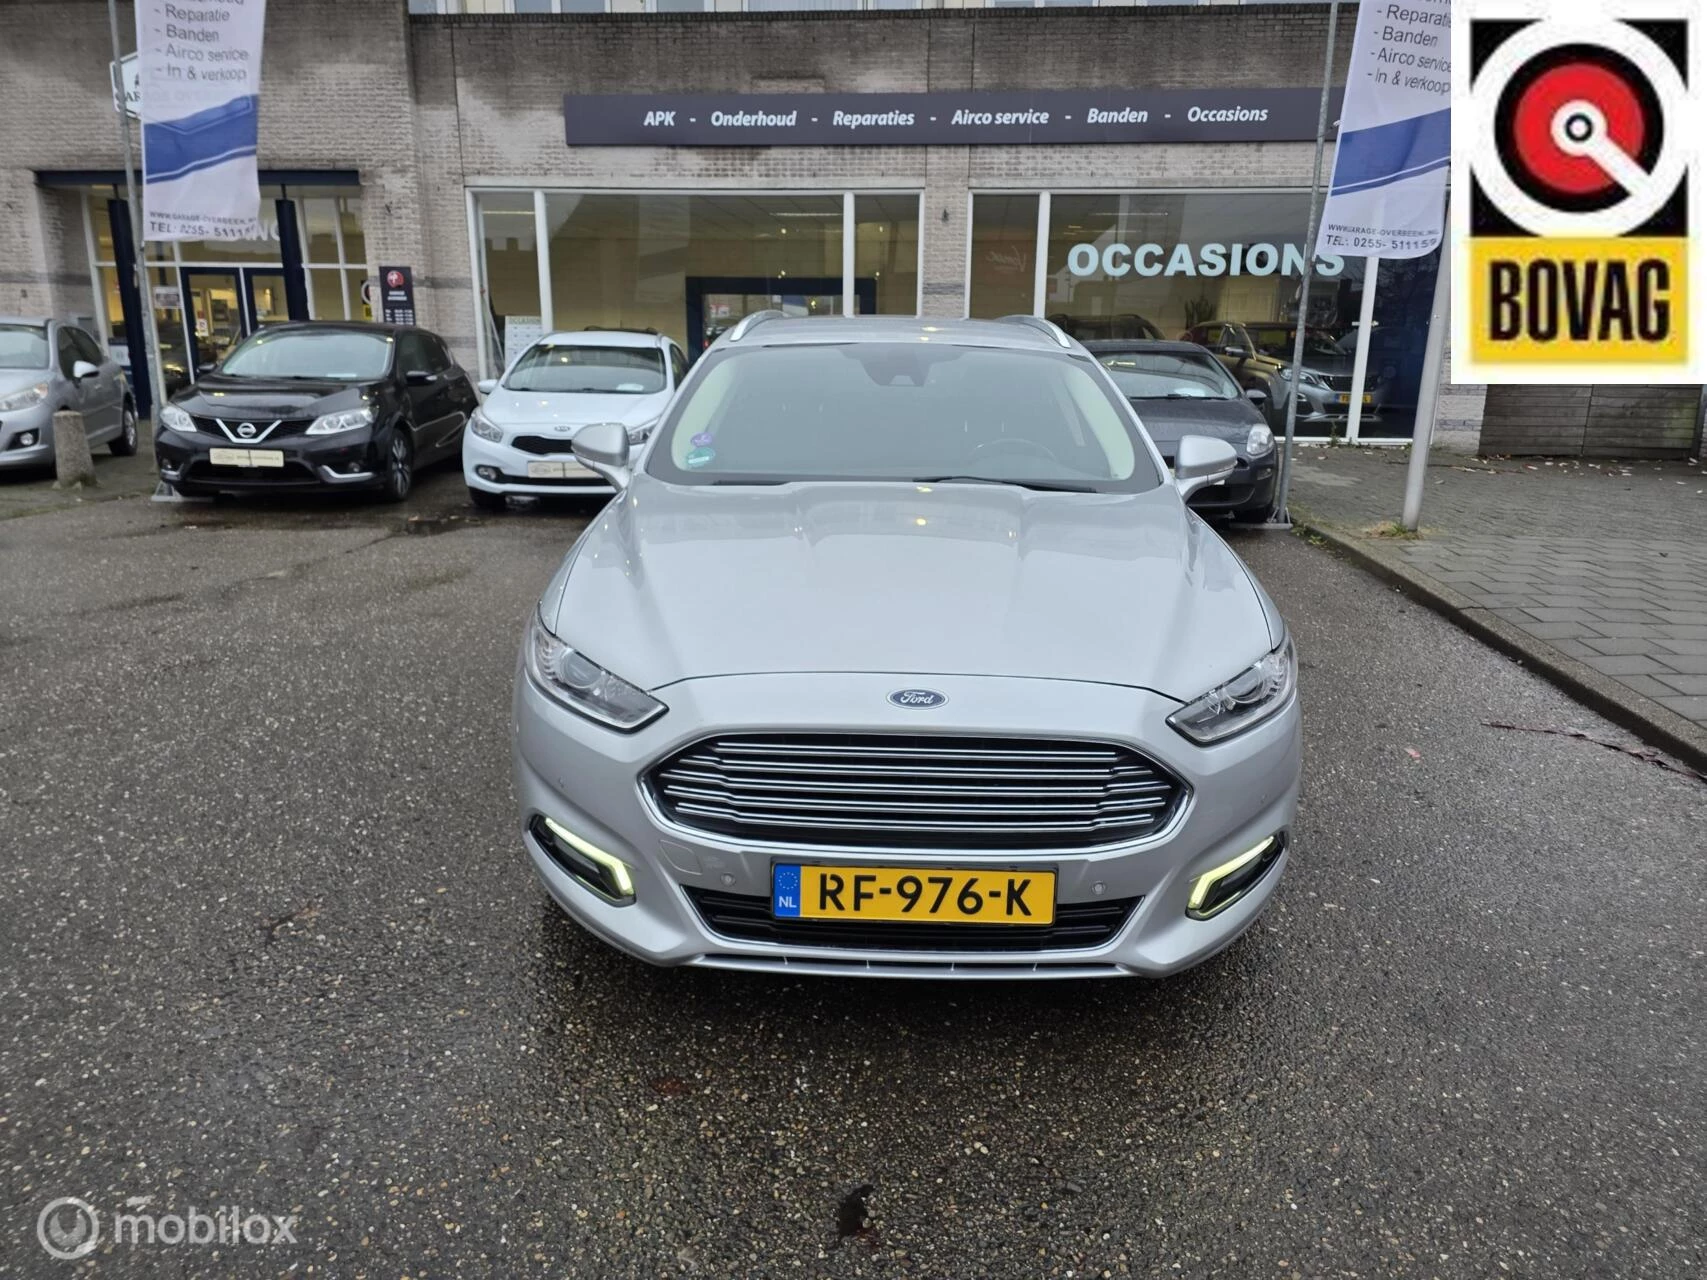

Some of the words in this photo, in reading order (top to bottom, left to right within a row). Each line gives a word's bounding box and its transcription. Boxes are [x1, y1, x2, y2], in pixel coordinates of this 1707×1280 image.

[165, 3, 230, 23] Reparatie
[166, 24, 220, 42] Banden
[1382, 26, 1438, 47] Banden
[165, 42, 204, 61] Airco
[1377, 47, 1415, 66] Airco
[1417, 56, 1451, 72] service
[167, 62, 181, 78] In
[187, 65, 197, 80] &
[200, 68, 247, 81] verkoop
[1375, 67, 1388, 84] In
[1391, 70, 1401, 86] &
[1404, 75, 1451, 95] verkoop
[644, 111, 676, 126] APK
[710, 110, 797, 127] Onderhoud
[832, 110, 915, 129] Reparaties
[951, 109, 993, 125] Airco
[994, 109, 1050, 125] service
[1086, 107, 1148, 124] Banden
[1187, 105, 1268, 122] Occasions
[1326, 234, 1350, 246] TEL:
[1067, 243, 1345, 277] OCCASIONS
[900, 690, 935, 704] Ford
[778, 896, 797, 908] NL
[819, 873, 1032, 916] RF-976-K
